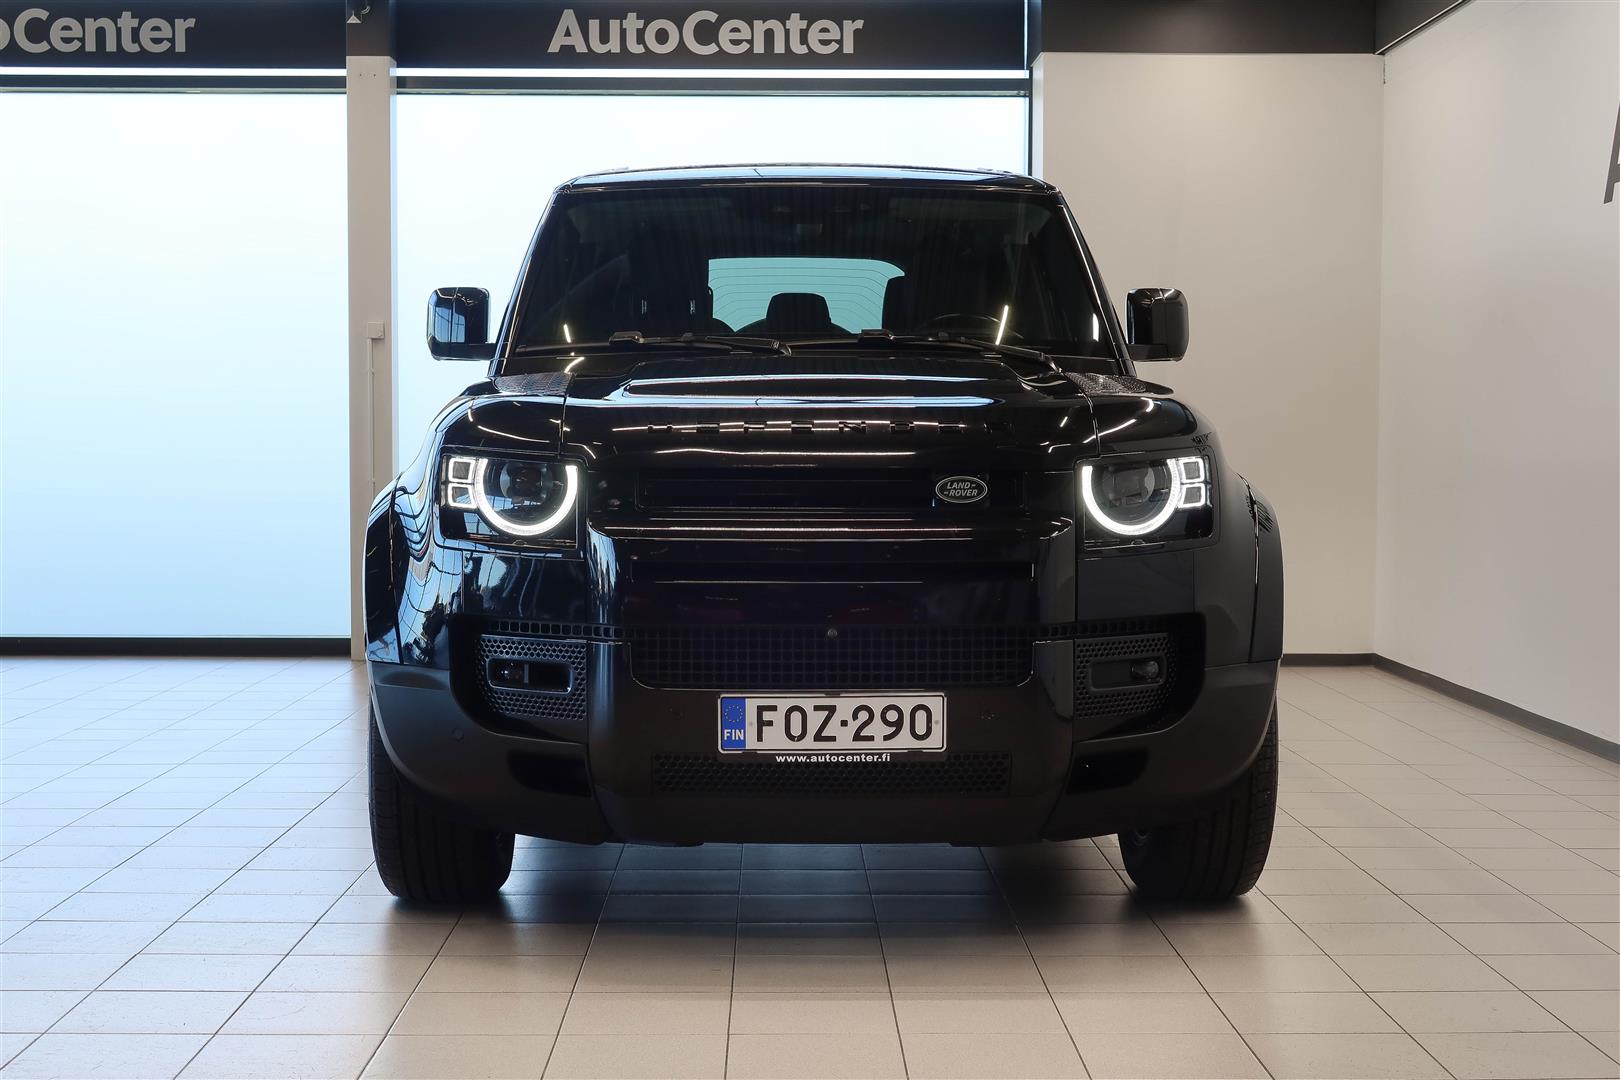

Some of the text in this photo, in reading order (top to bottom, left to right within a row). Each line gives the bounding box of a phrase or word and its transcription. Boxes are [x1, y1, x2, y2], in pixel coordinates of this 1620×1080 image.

[0, 8, 196, 53] Center
[547, 9, 864, 55] AutoCenter
[724, 729, 744, 740] FIN
[756, 704, 933, 742] FOZ-290
[775, 753, 890, 762] www.autocenter.fi
